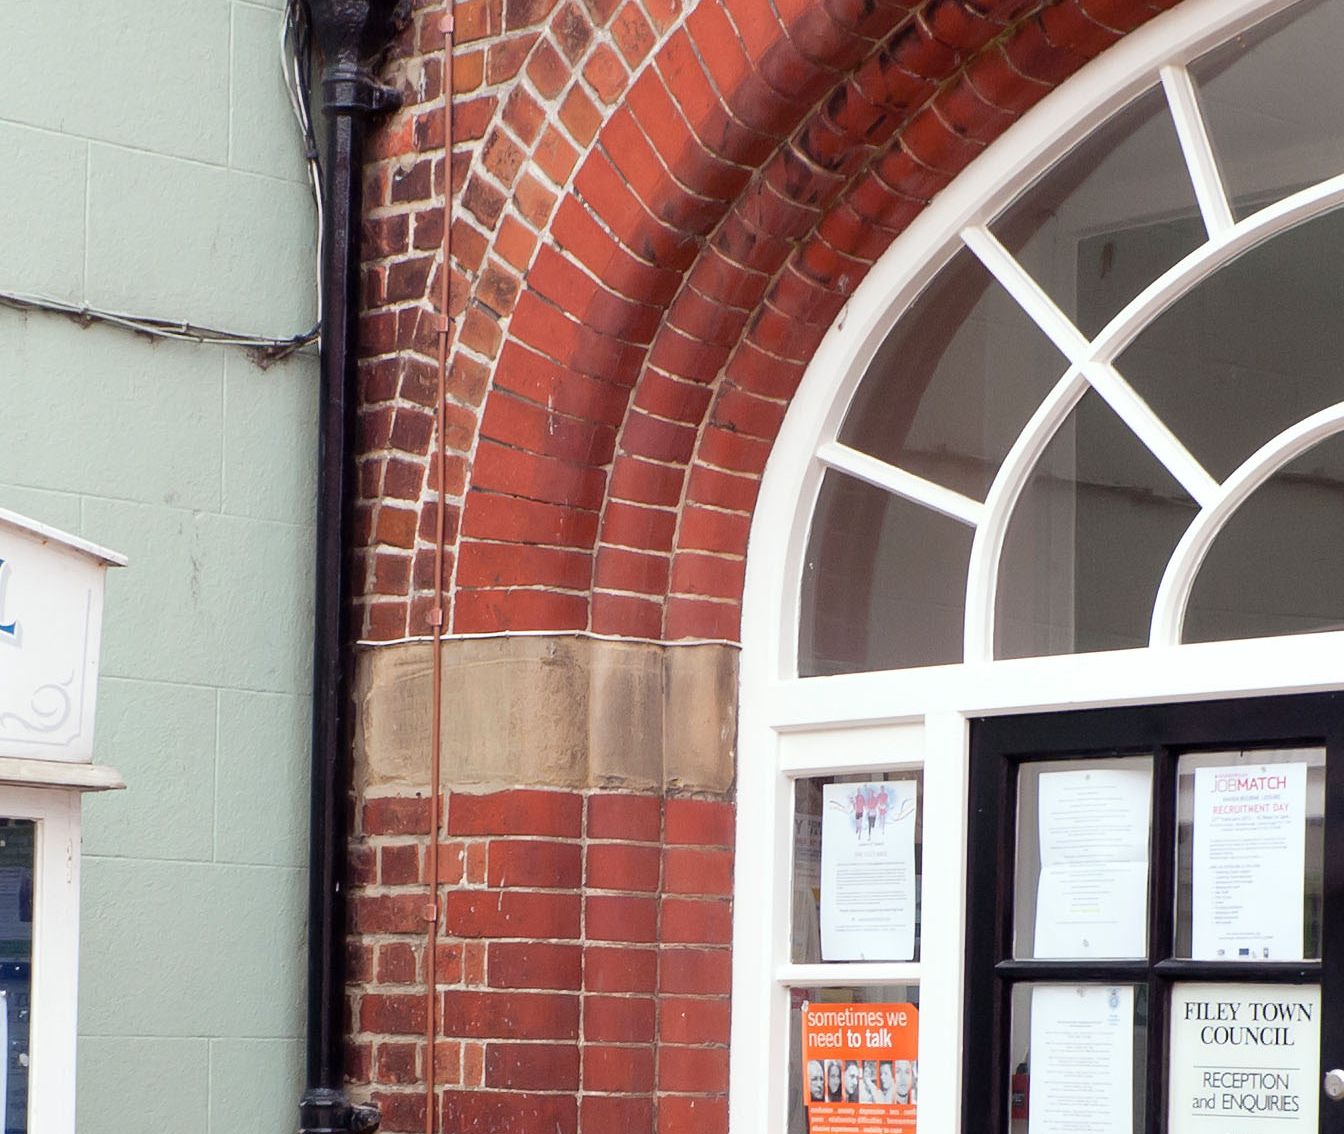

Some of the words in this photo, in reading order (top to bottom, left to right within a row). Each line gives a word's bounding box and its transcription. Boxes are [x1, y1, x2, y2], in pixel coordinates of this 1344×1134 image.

[1213, 803, 1270, 815] RECRUITMENT
[1272, 803, 1288, 812] DAY
[808, 1007, 884, 1027] sometimes
[886, 1011, 907, 1027] we
[1184, 1001, 1241, 1021] FILEY
[1249, 1002, 1313, 1022] TOWN
[808, 1029, 842, 1048] need
[847, 1030, 861, 1048] to
[866, 1028, 892, 1048] talk
[1201, 1026, 1295, 1046] COUNCIL
[1203, 1071, 1289, 1090] RECEPTION
[1192, 1093, 1216, 1110] and
[1222, 1094, 1300, 1113] ENQUIRIES
